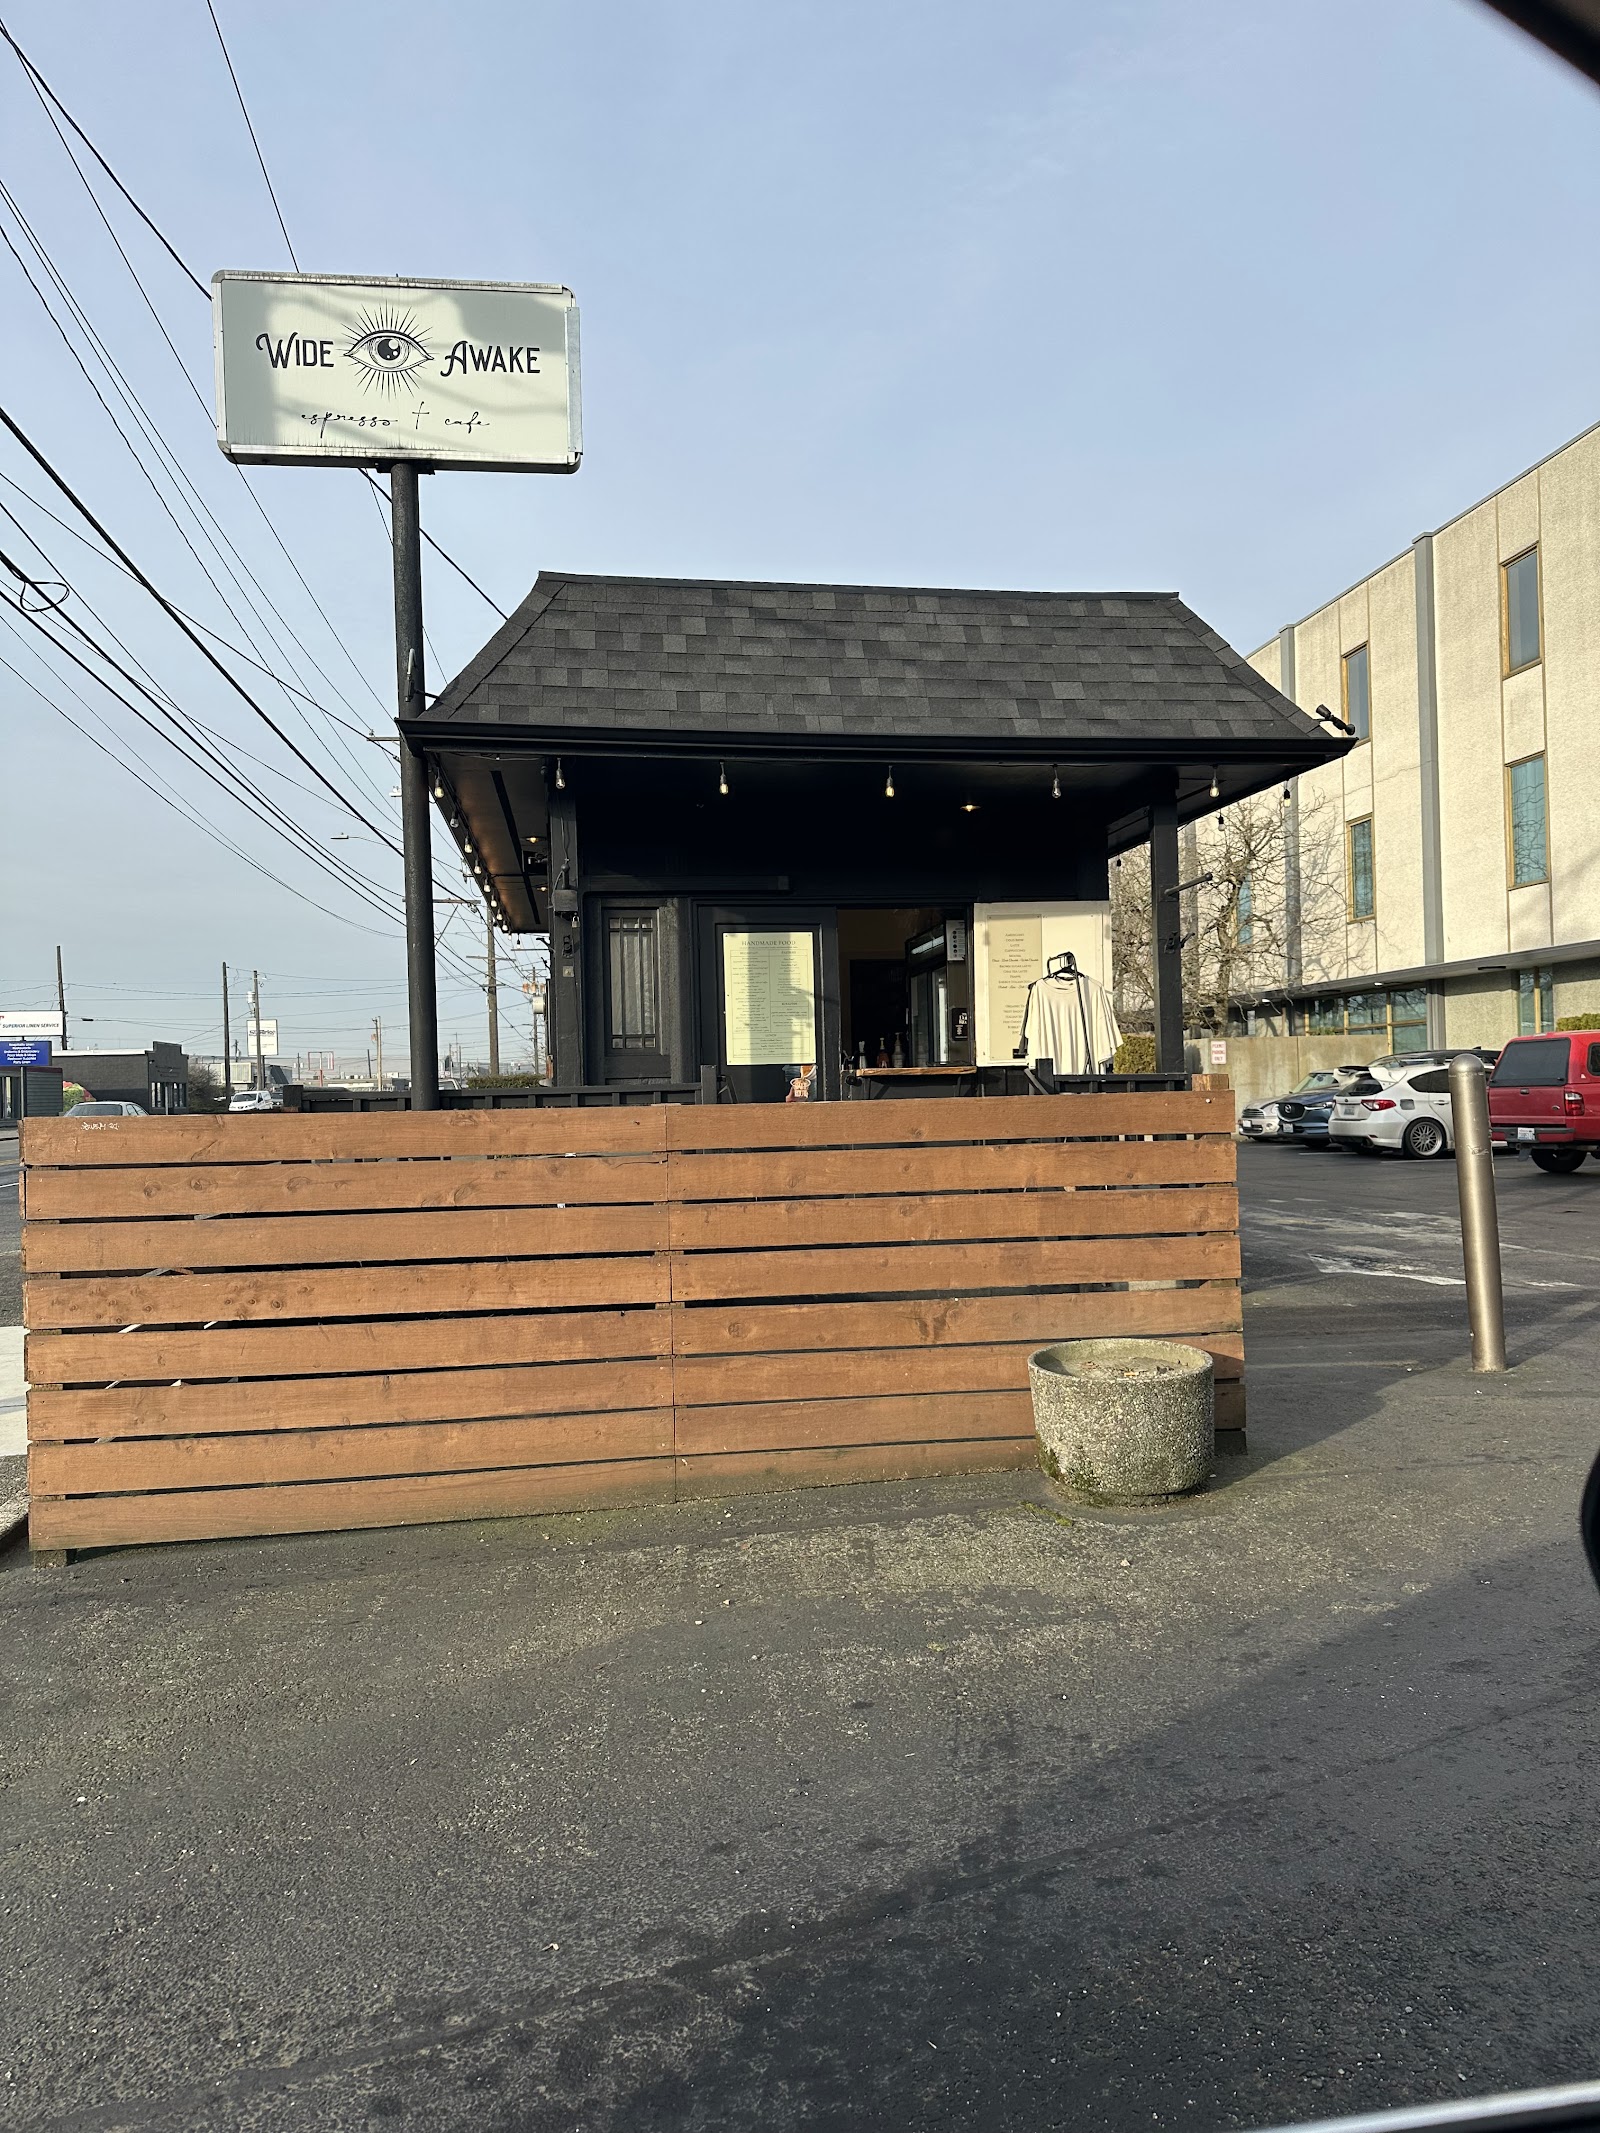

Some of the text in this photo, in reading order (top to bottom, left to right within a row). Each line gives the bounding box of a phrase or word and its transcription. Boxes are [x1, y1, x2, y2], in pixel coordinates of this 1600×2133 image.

[256, 332, 541, 377] WIDE AWAKE
[301, 411, 398, 439] espresso
[444, 411, 490, 434] cafe
